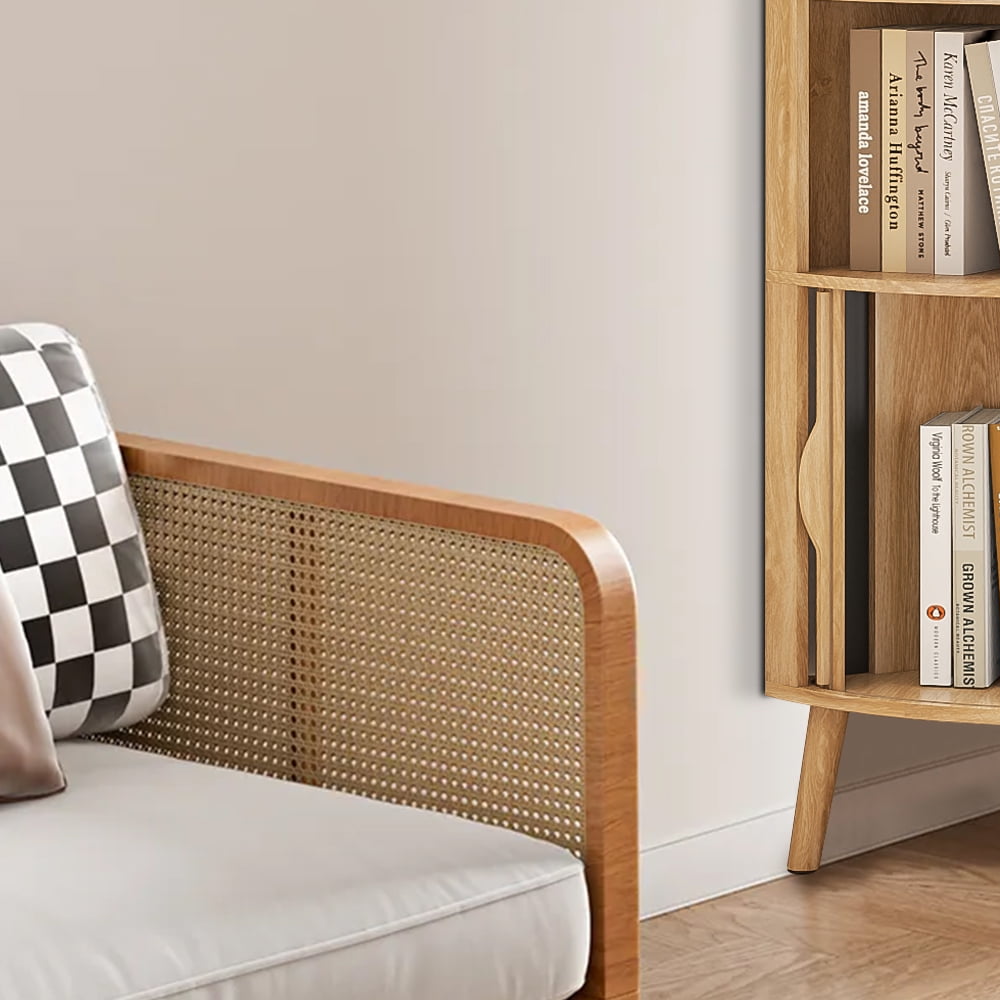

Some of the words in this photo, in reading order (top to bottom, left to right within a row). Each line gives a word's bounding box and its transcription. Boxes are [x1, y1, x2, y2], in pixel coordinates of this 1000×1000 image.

[913, 51, 928, 81] The
[943, 52, 958, 88] Karen
[858, 91, 873, 149] amanda
[889, 73, 903, 135] Arianna
[939, 93, 958, 161] McCartney
[907, 125, 929, 173] beyond
[858, 153, 873, 214] lovelace
[884, 142, 904, 230] Huffington
[929, 432, 943, 460] Virginia
[962, 425, 975, 464] ROWN
[962, 468, 975, 539] ALCHEMIST
[962, 563, 975, 613] GROWN
[962, 618, 976, 687] ALCHEMIS
